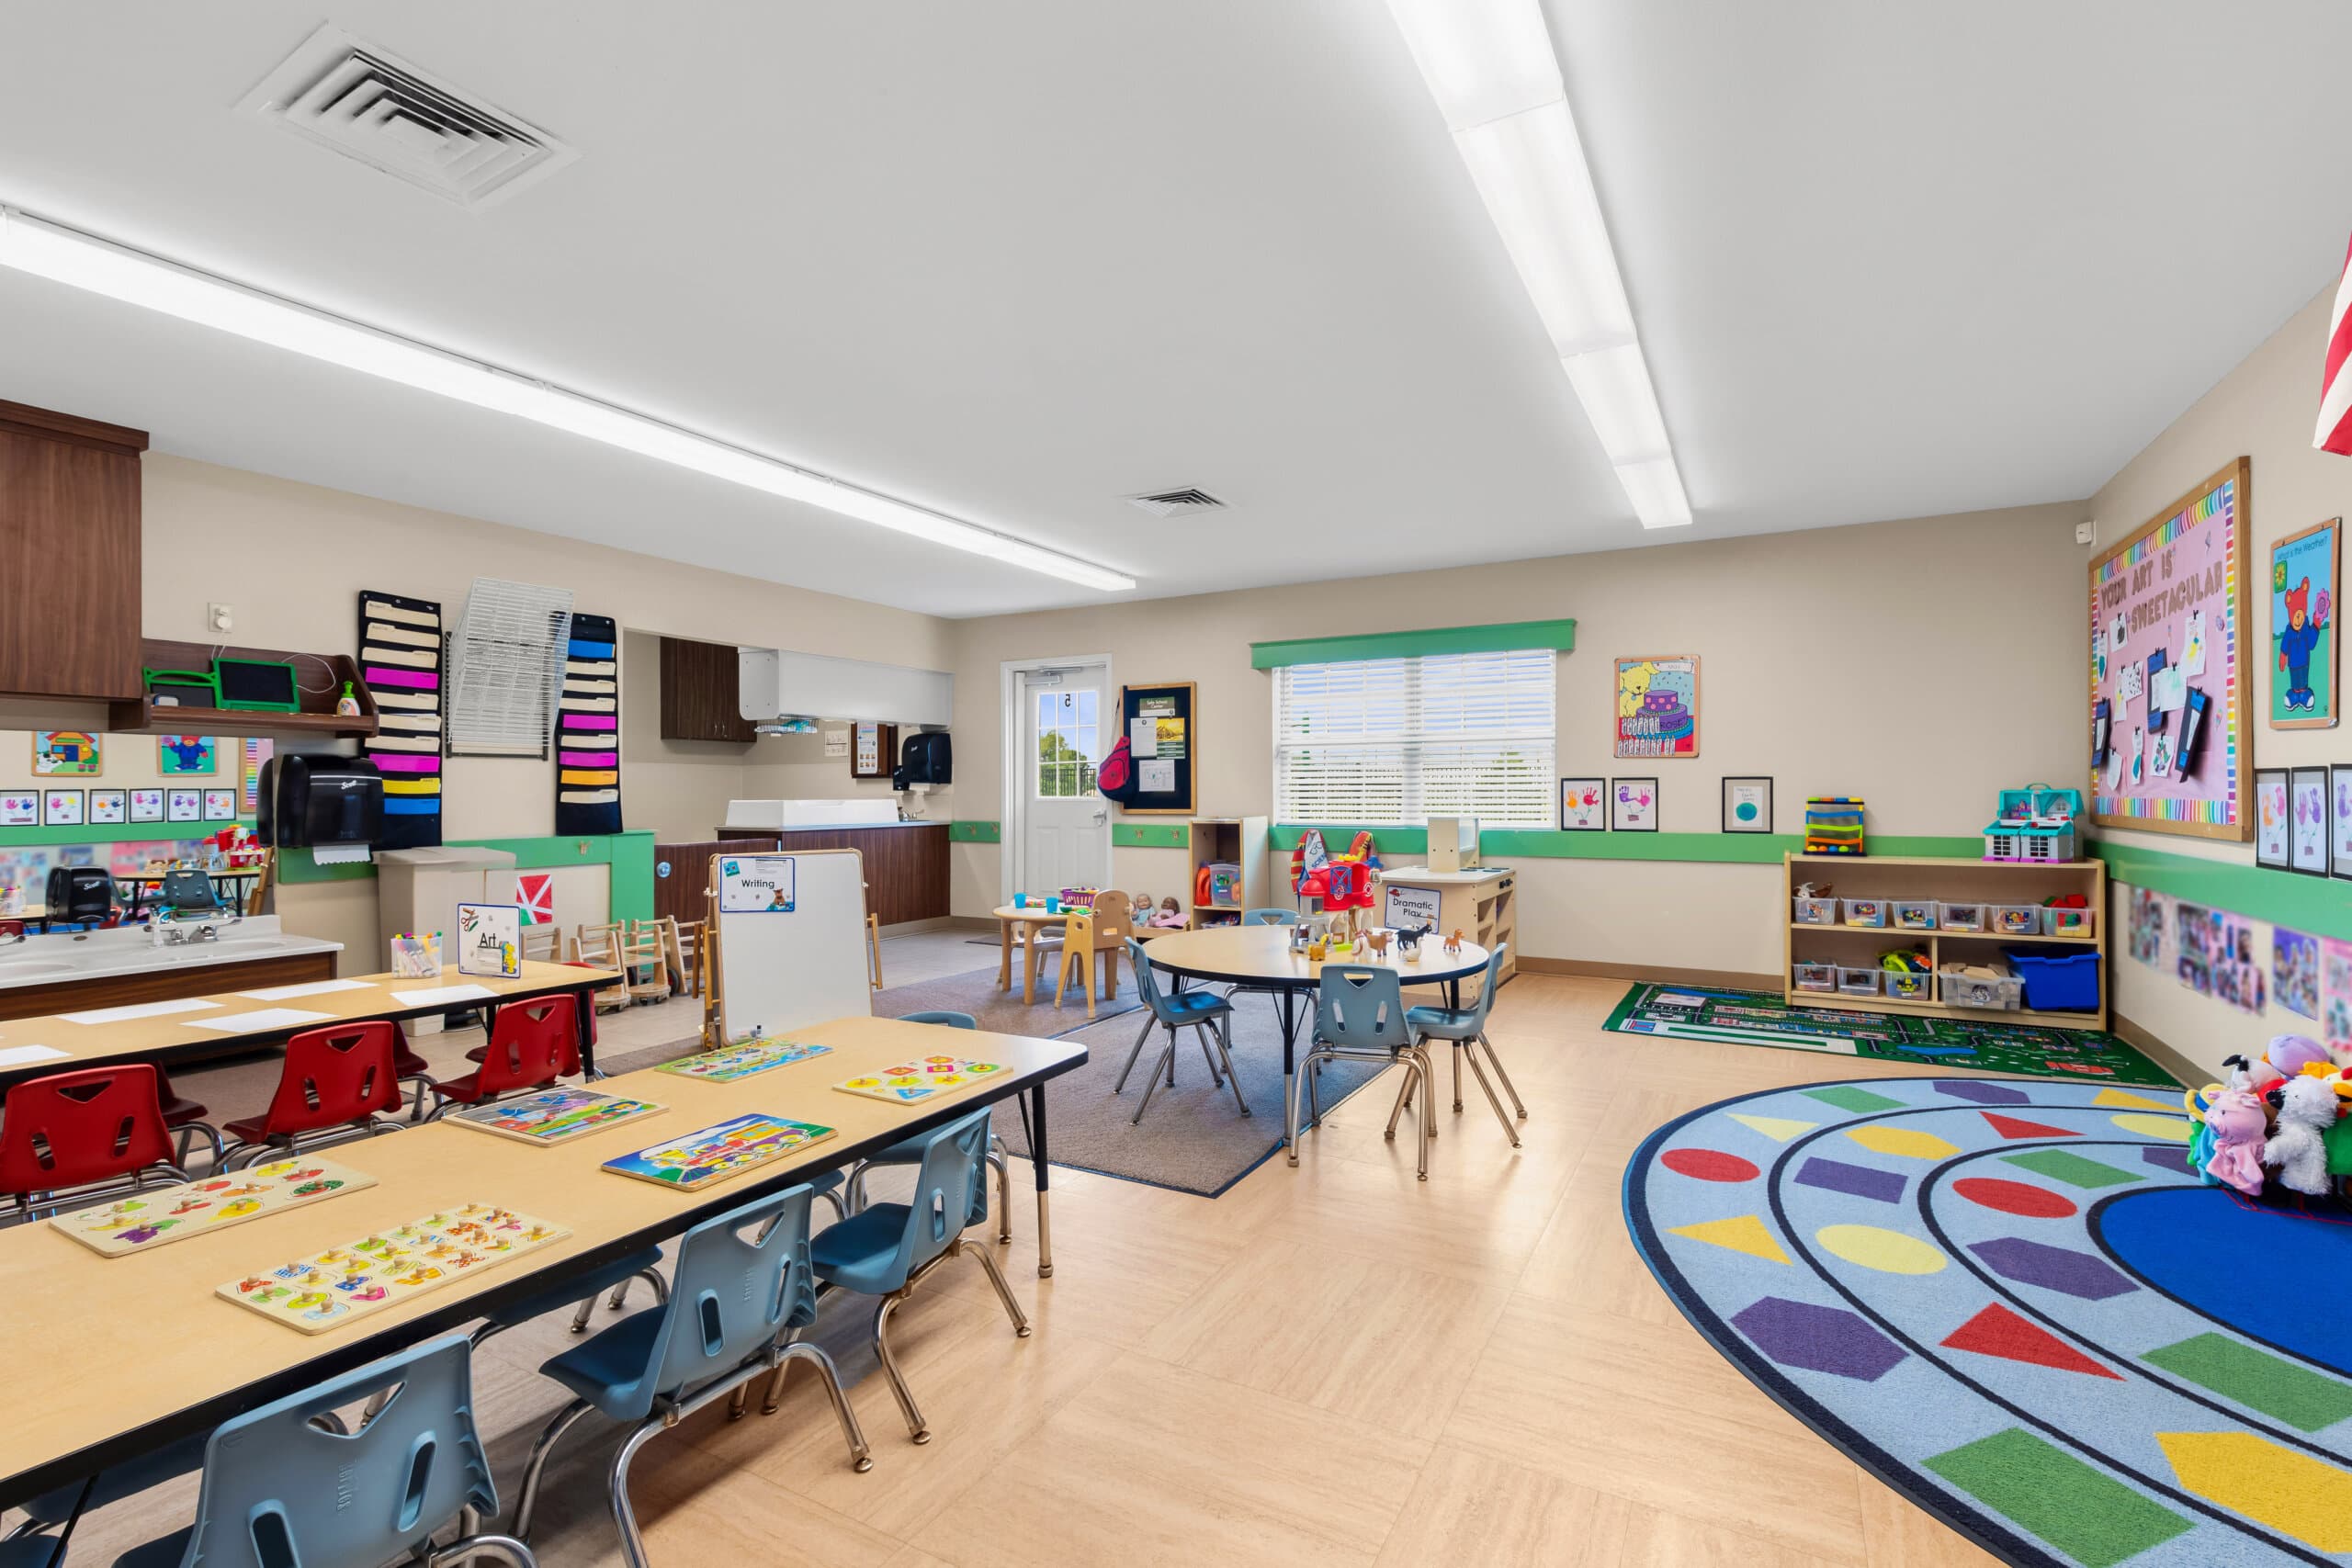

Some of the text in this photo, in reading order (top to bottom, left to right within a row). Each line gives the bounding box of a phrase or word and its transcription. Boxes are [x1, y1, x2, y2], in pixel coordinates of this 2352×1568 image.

[2100, 549, 2173, 611] YOUR ART IS
[2131, 561, 2222, 634] SWEETACULAR
[341, 780, 356, 790] Scott
[741, 879, 775, 890] Writing
[1393, 897, 1433, 910] Dramatic
[1403, 908, 1421, 918] Play
[480, 932, 496, 948] Art
